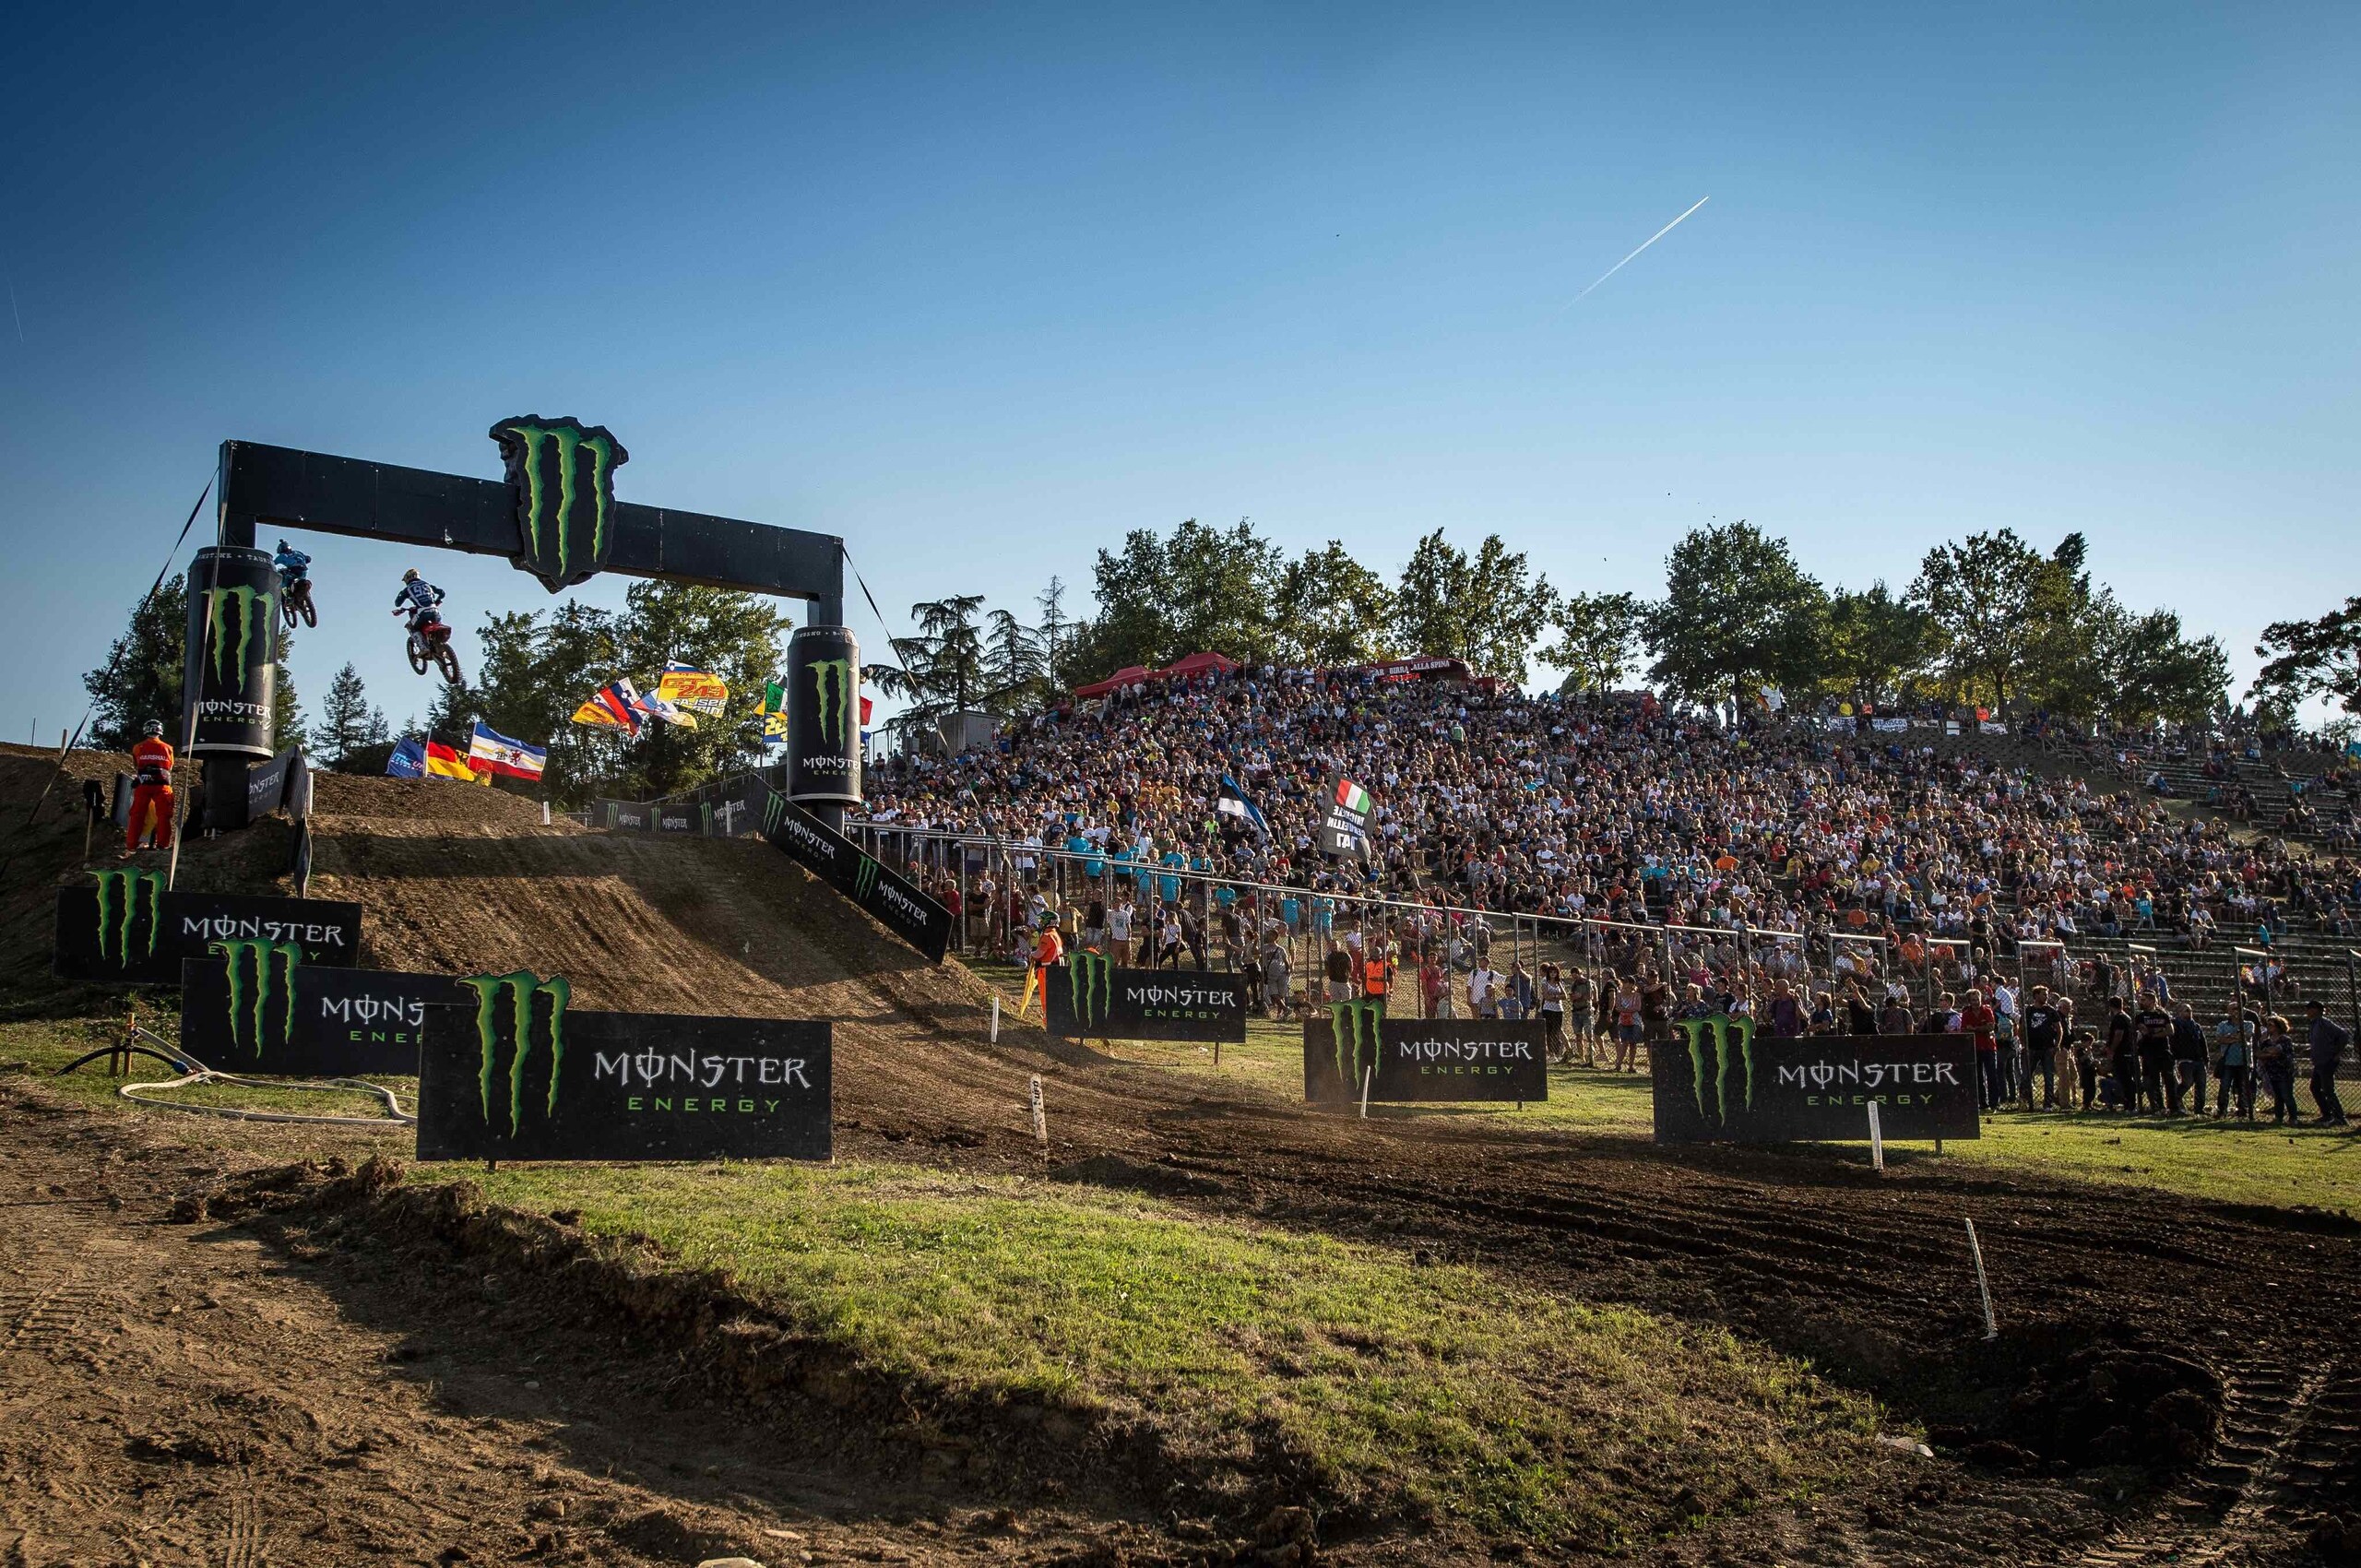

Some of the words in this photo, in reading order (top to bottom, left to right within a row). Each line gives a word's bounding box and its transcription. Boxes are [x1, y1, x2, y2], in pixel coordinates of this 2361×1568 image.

[1389, 665, 1409, 675] BIRRA
[1413, 662, 1430, 671] ALLA
[1430, 659, 1451, 669] SPINA
[677, 684, 727, 700] 243
[203, 716, 264, 726] ENERGY
[802, 754, 861, 769] MONSTE
[249, 771, 279, 794] ONSTER
[618, 814, 641, 826] MONSTER
[662, 816, 688, 829] MONSTER
[784, 815, 836, 860] MONSTER
[878, 880, 927, 926] MONSTER
[183, 914, 346, 947] MONSTER
[1126, 984, 1237, 1008] MONSTER
[321, 994, 424, 1027] MONS
[1145, 1009, 1220, 1020] ENERGY
[1399, 1037, 1534, 1062] MONSTER
[594, 1046, 812, 1089] MONSTER
[1421, 1066, 1513, 1075] ENERGY
[1778, 1059, 1960, 1090] MONSTER
[627, 1097, 780, 1112] ENERGY
[1807, 1094, 1933, 1106] ENERGY
